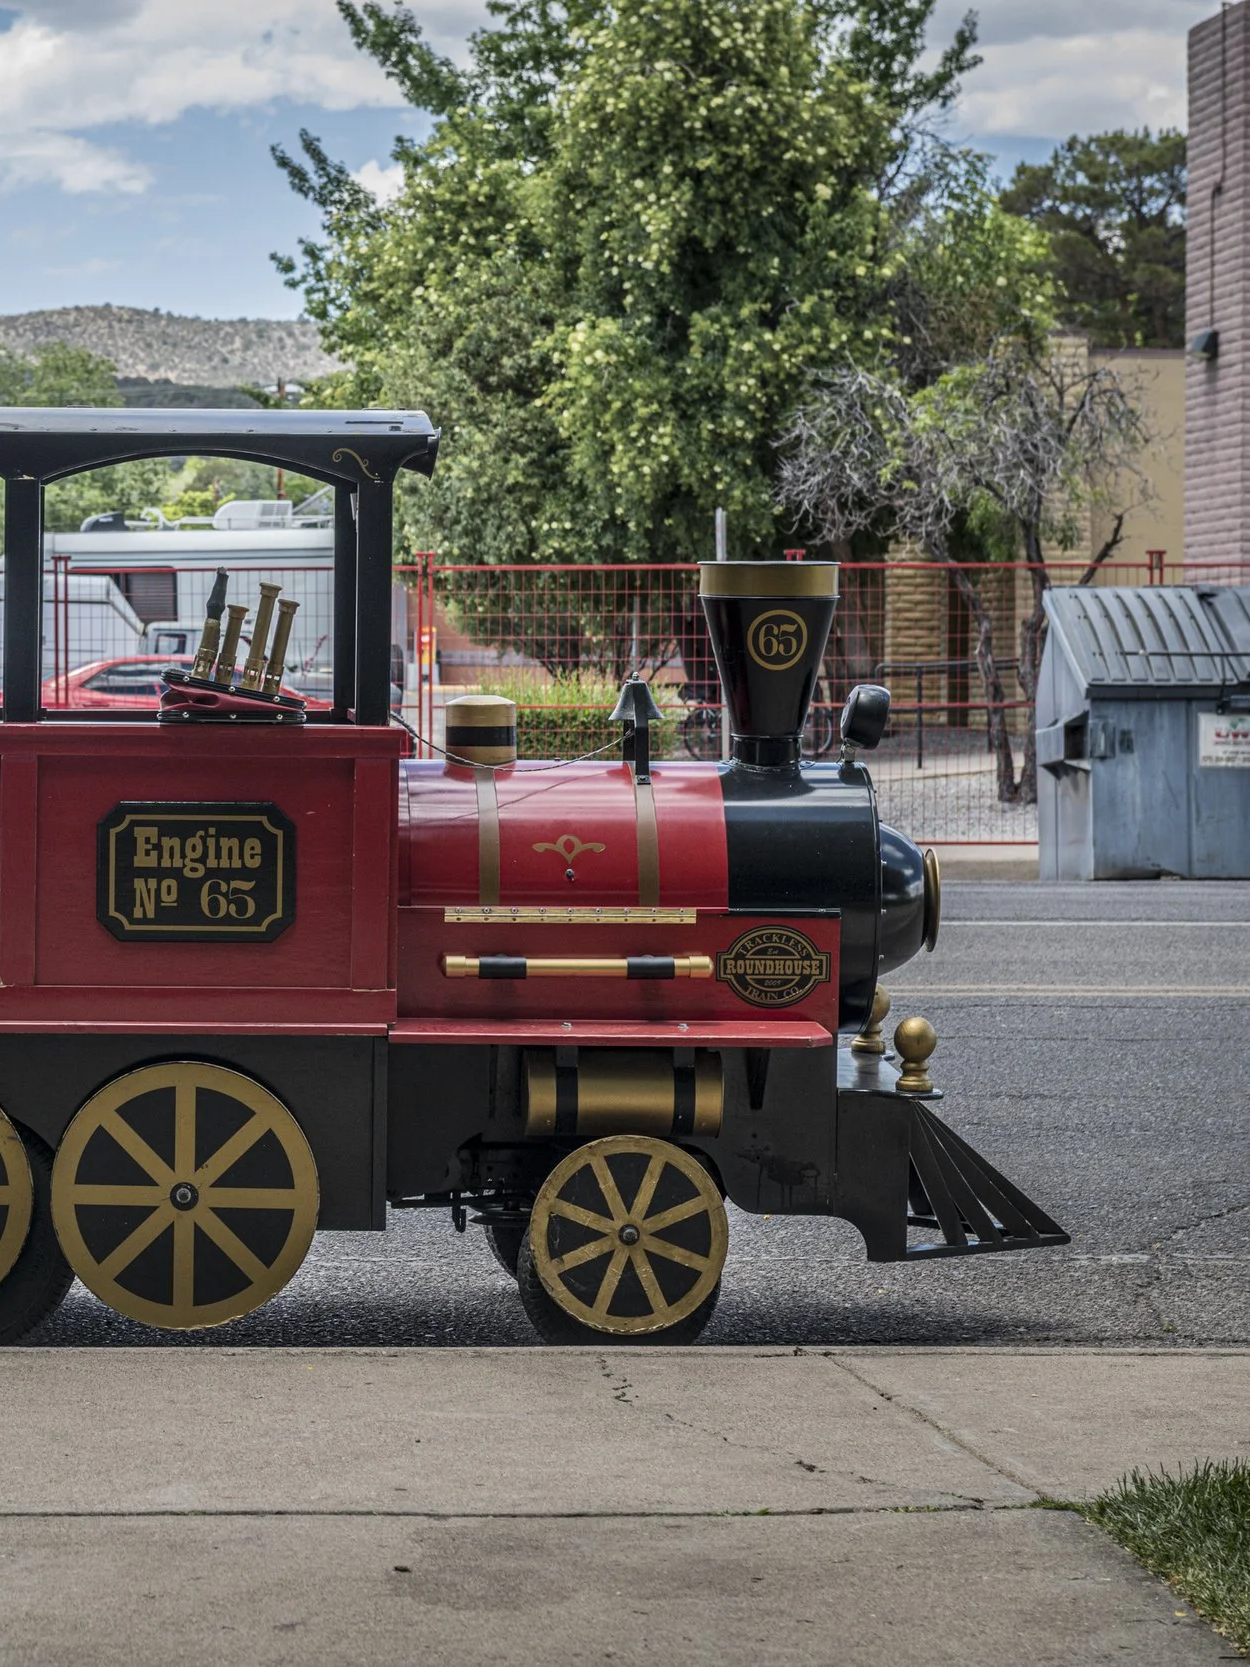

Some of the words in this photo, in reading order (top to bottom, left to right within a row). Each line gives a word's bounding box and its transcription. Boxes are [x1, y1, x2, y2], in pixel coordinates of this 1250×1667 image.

[758, 622, 799, 657] 65
[133, 826, 263, 879] Engine
[199, 879, 257, 919] 65
[738, 933, 809, 957] TRACKLESS
[725, 959, 820, 975] ROUNDHOUSE
[746, 985, 779, 1001] TRAIN
